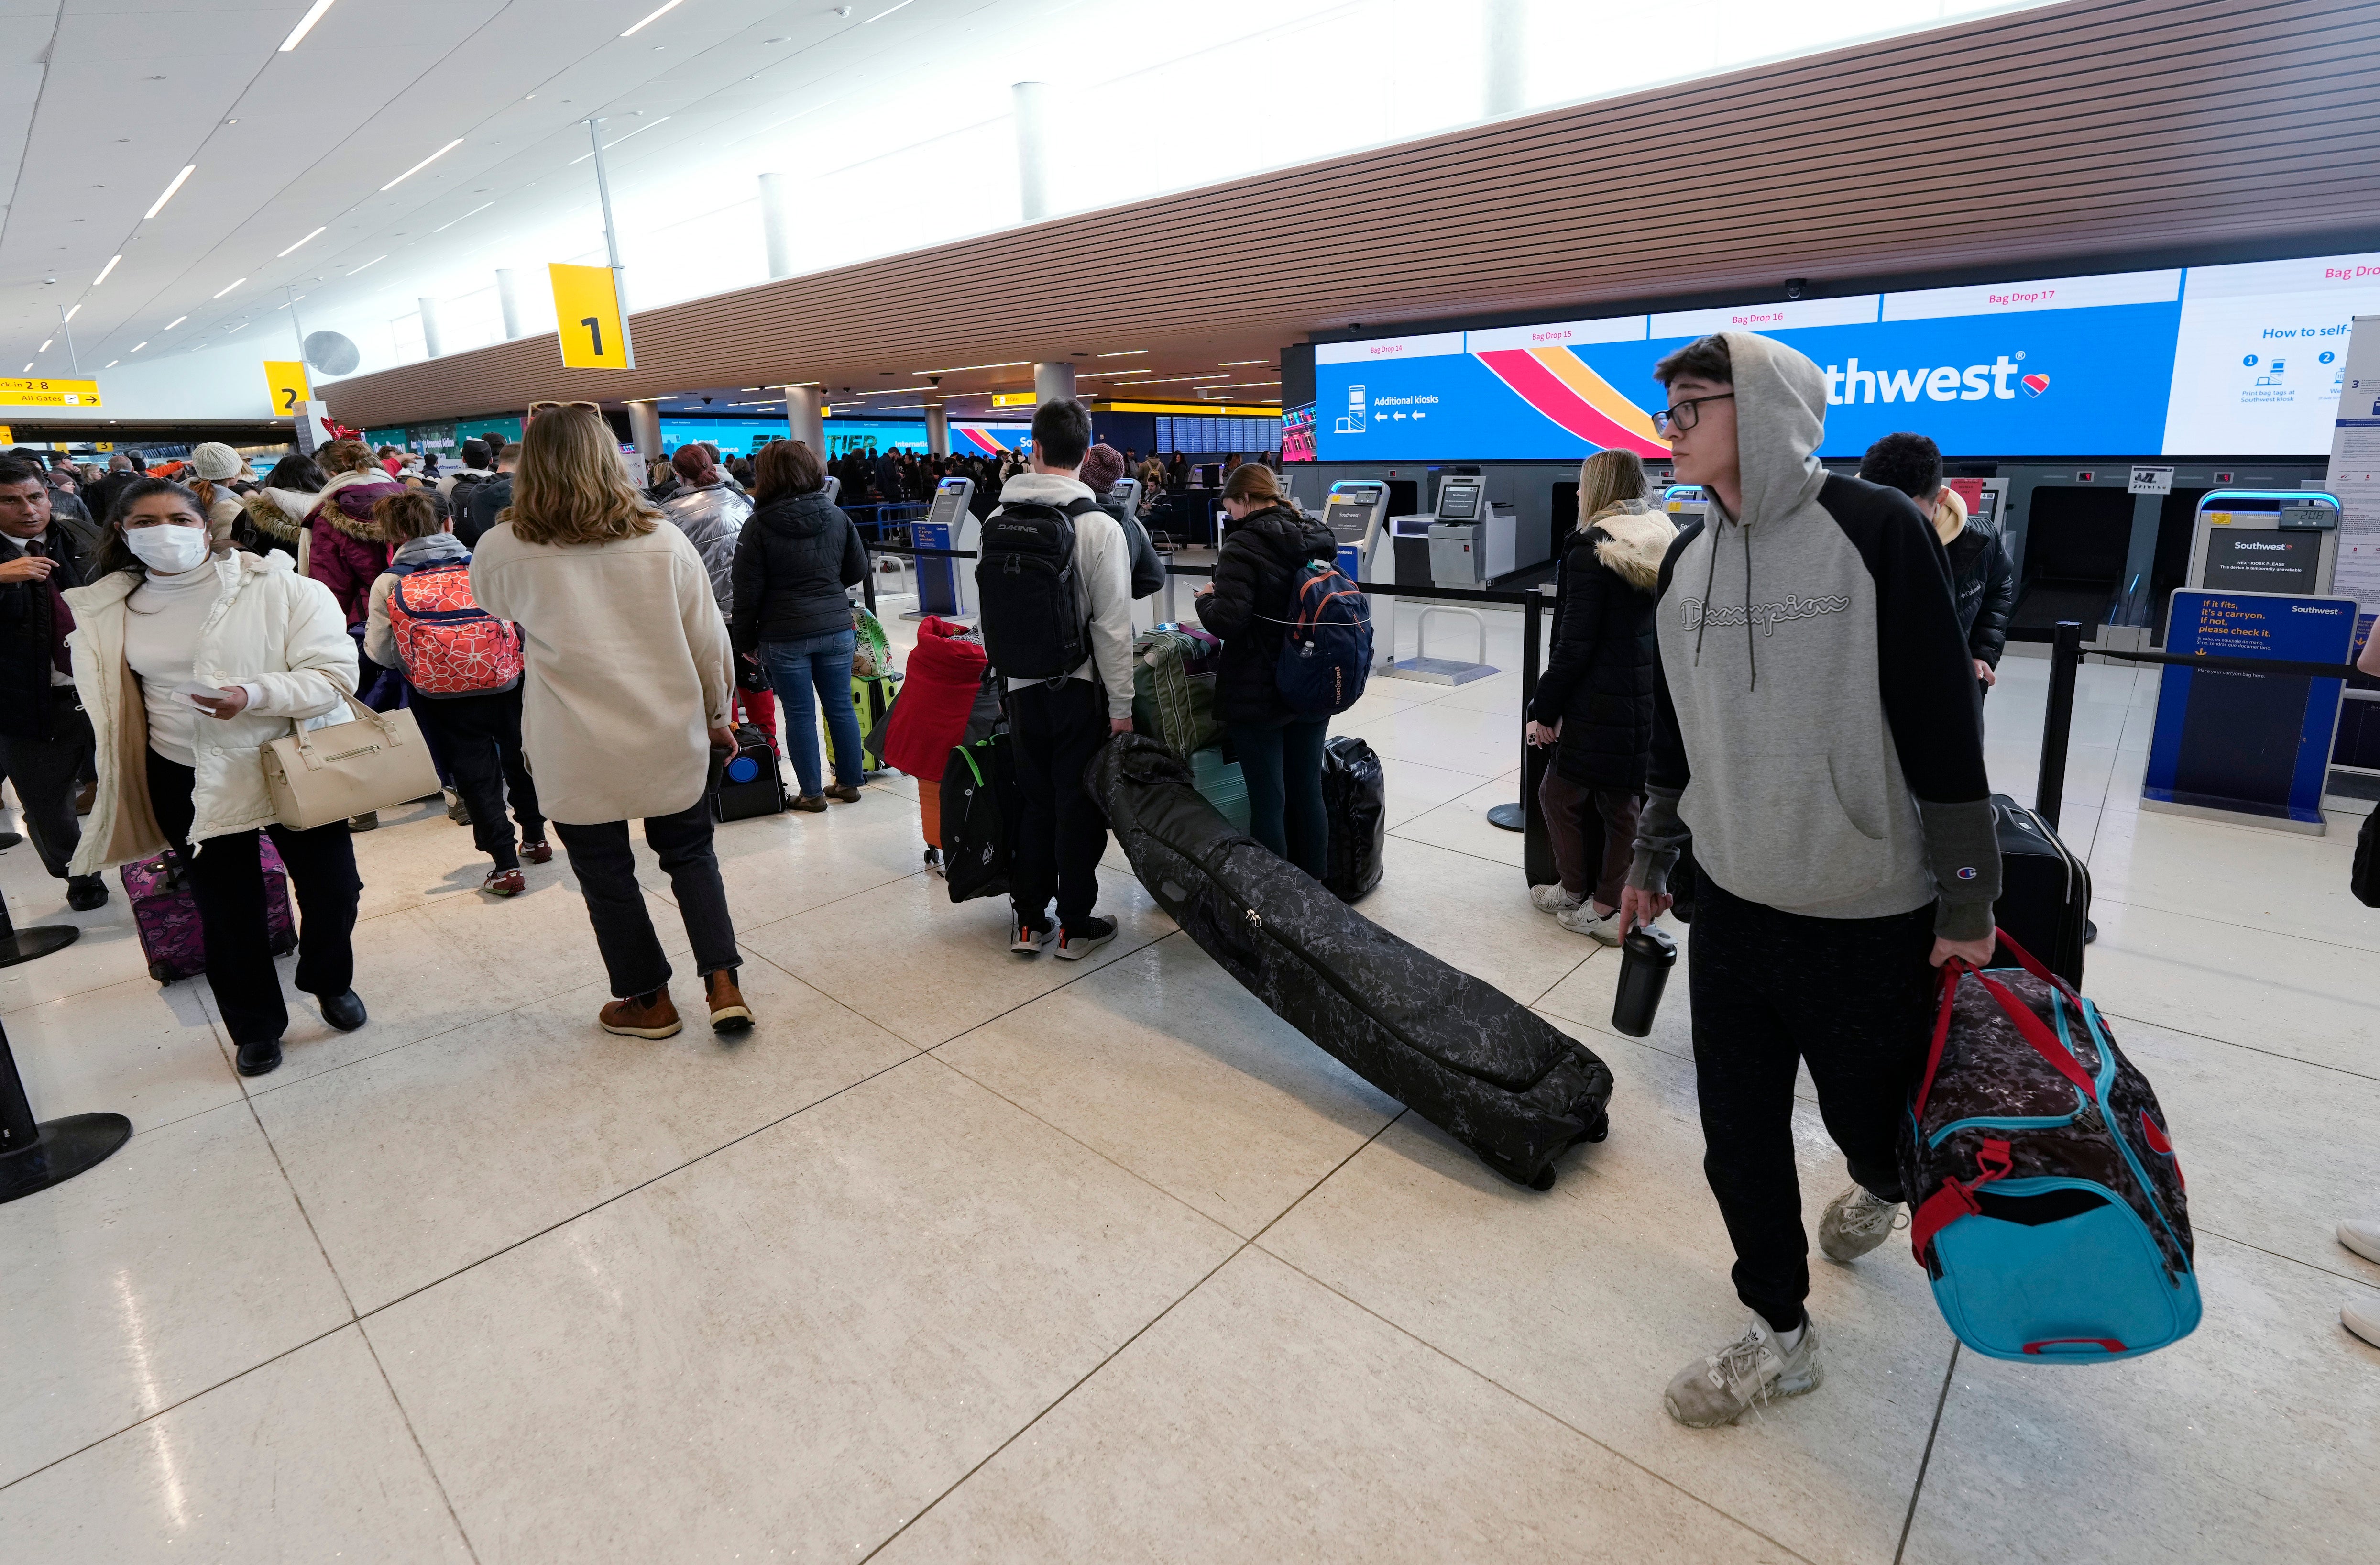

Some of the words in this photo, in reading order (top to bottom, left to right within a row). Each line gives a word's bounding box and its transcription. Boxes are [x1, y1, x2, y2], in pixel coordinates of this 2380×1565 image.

[2325, 268, 2352, 280] Bag
[2356, 266, 2380, 276] Dro
[1989, 294, 2009, 305] Bag
[2011, 292, 2038, 302] Drop
[2041, 290, 2055, 299] 17
[1732, 315, 1748, 326] Bag
[1750, 314, 1771, 324] Drop
[1773, 313, 1784, 321] 16
[580, 317, 603, 356] 1
[1532, 332, 1544, 342] Bag
[1545, 331, 1561, 341] Drop
[2262, 328, 2297, 339] How
[2301, 328, 2315, 337] to
[2319, 324, 2352, 336] self-
[1370, 347, 1381, 355] Bag
[1382, 346, 1393, 354] Drop
[2248, 355, 2254, 364] 1
[2323, 353, 2332, 362] 2
[25, 381, 49, 390] 2-8
[1825, 355, 2018, 406] thwest
[2351, 380, 2360, 388] 3
[281, 388, 297, 409] 2
[1374, 395, 1413, 406] Additional
[1414, 394, 1439, 404] kiosks
[997, 524, 1039, 534] DAKINE
[2234, 541, 2285, 551] Southwest
[2221, 601, 2238, 610] fits,
[2292, 606, 2339, 615] Southwest
[2202, 608, 2215, 617] it's
[2225, 611, 2266, 620] carryon.
[2198, 626, 2229, 634] please
[2231, 628, 2259, 637] check
[2261, 629, 2271, 637] it.
